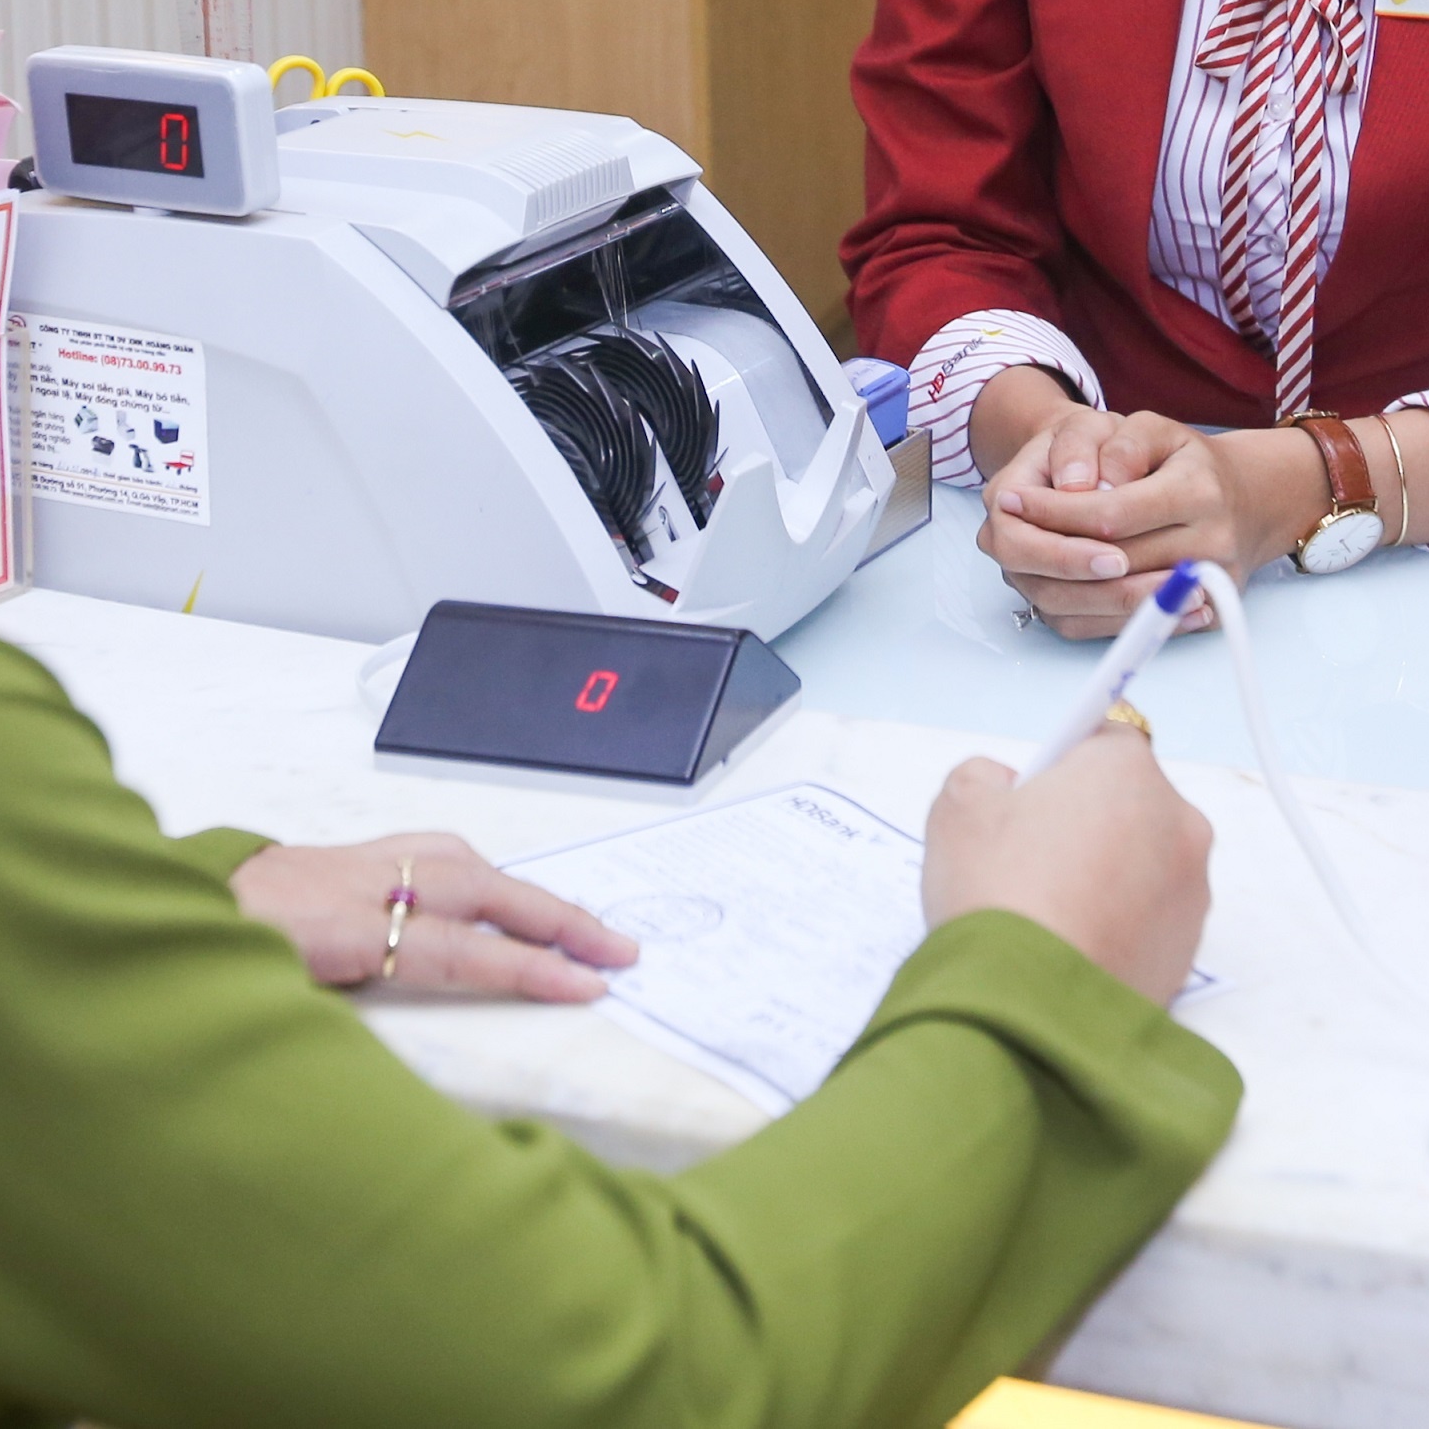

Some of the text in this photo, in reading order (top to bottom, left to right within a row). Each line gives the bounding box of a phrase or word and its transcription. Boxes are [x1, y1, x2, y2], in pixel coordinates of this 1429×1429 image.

[160, 113, 189, 170] 0
[58, 348, 182, 375] Hotline: (08)73.00.99.73
[928, 335, 986, 403] HDBank
[575, 670, 620, 715] 0
